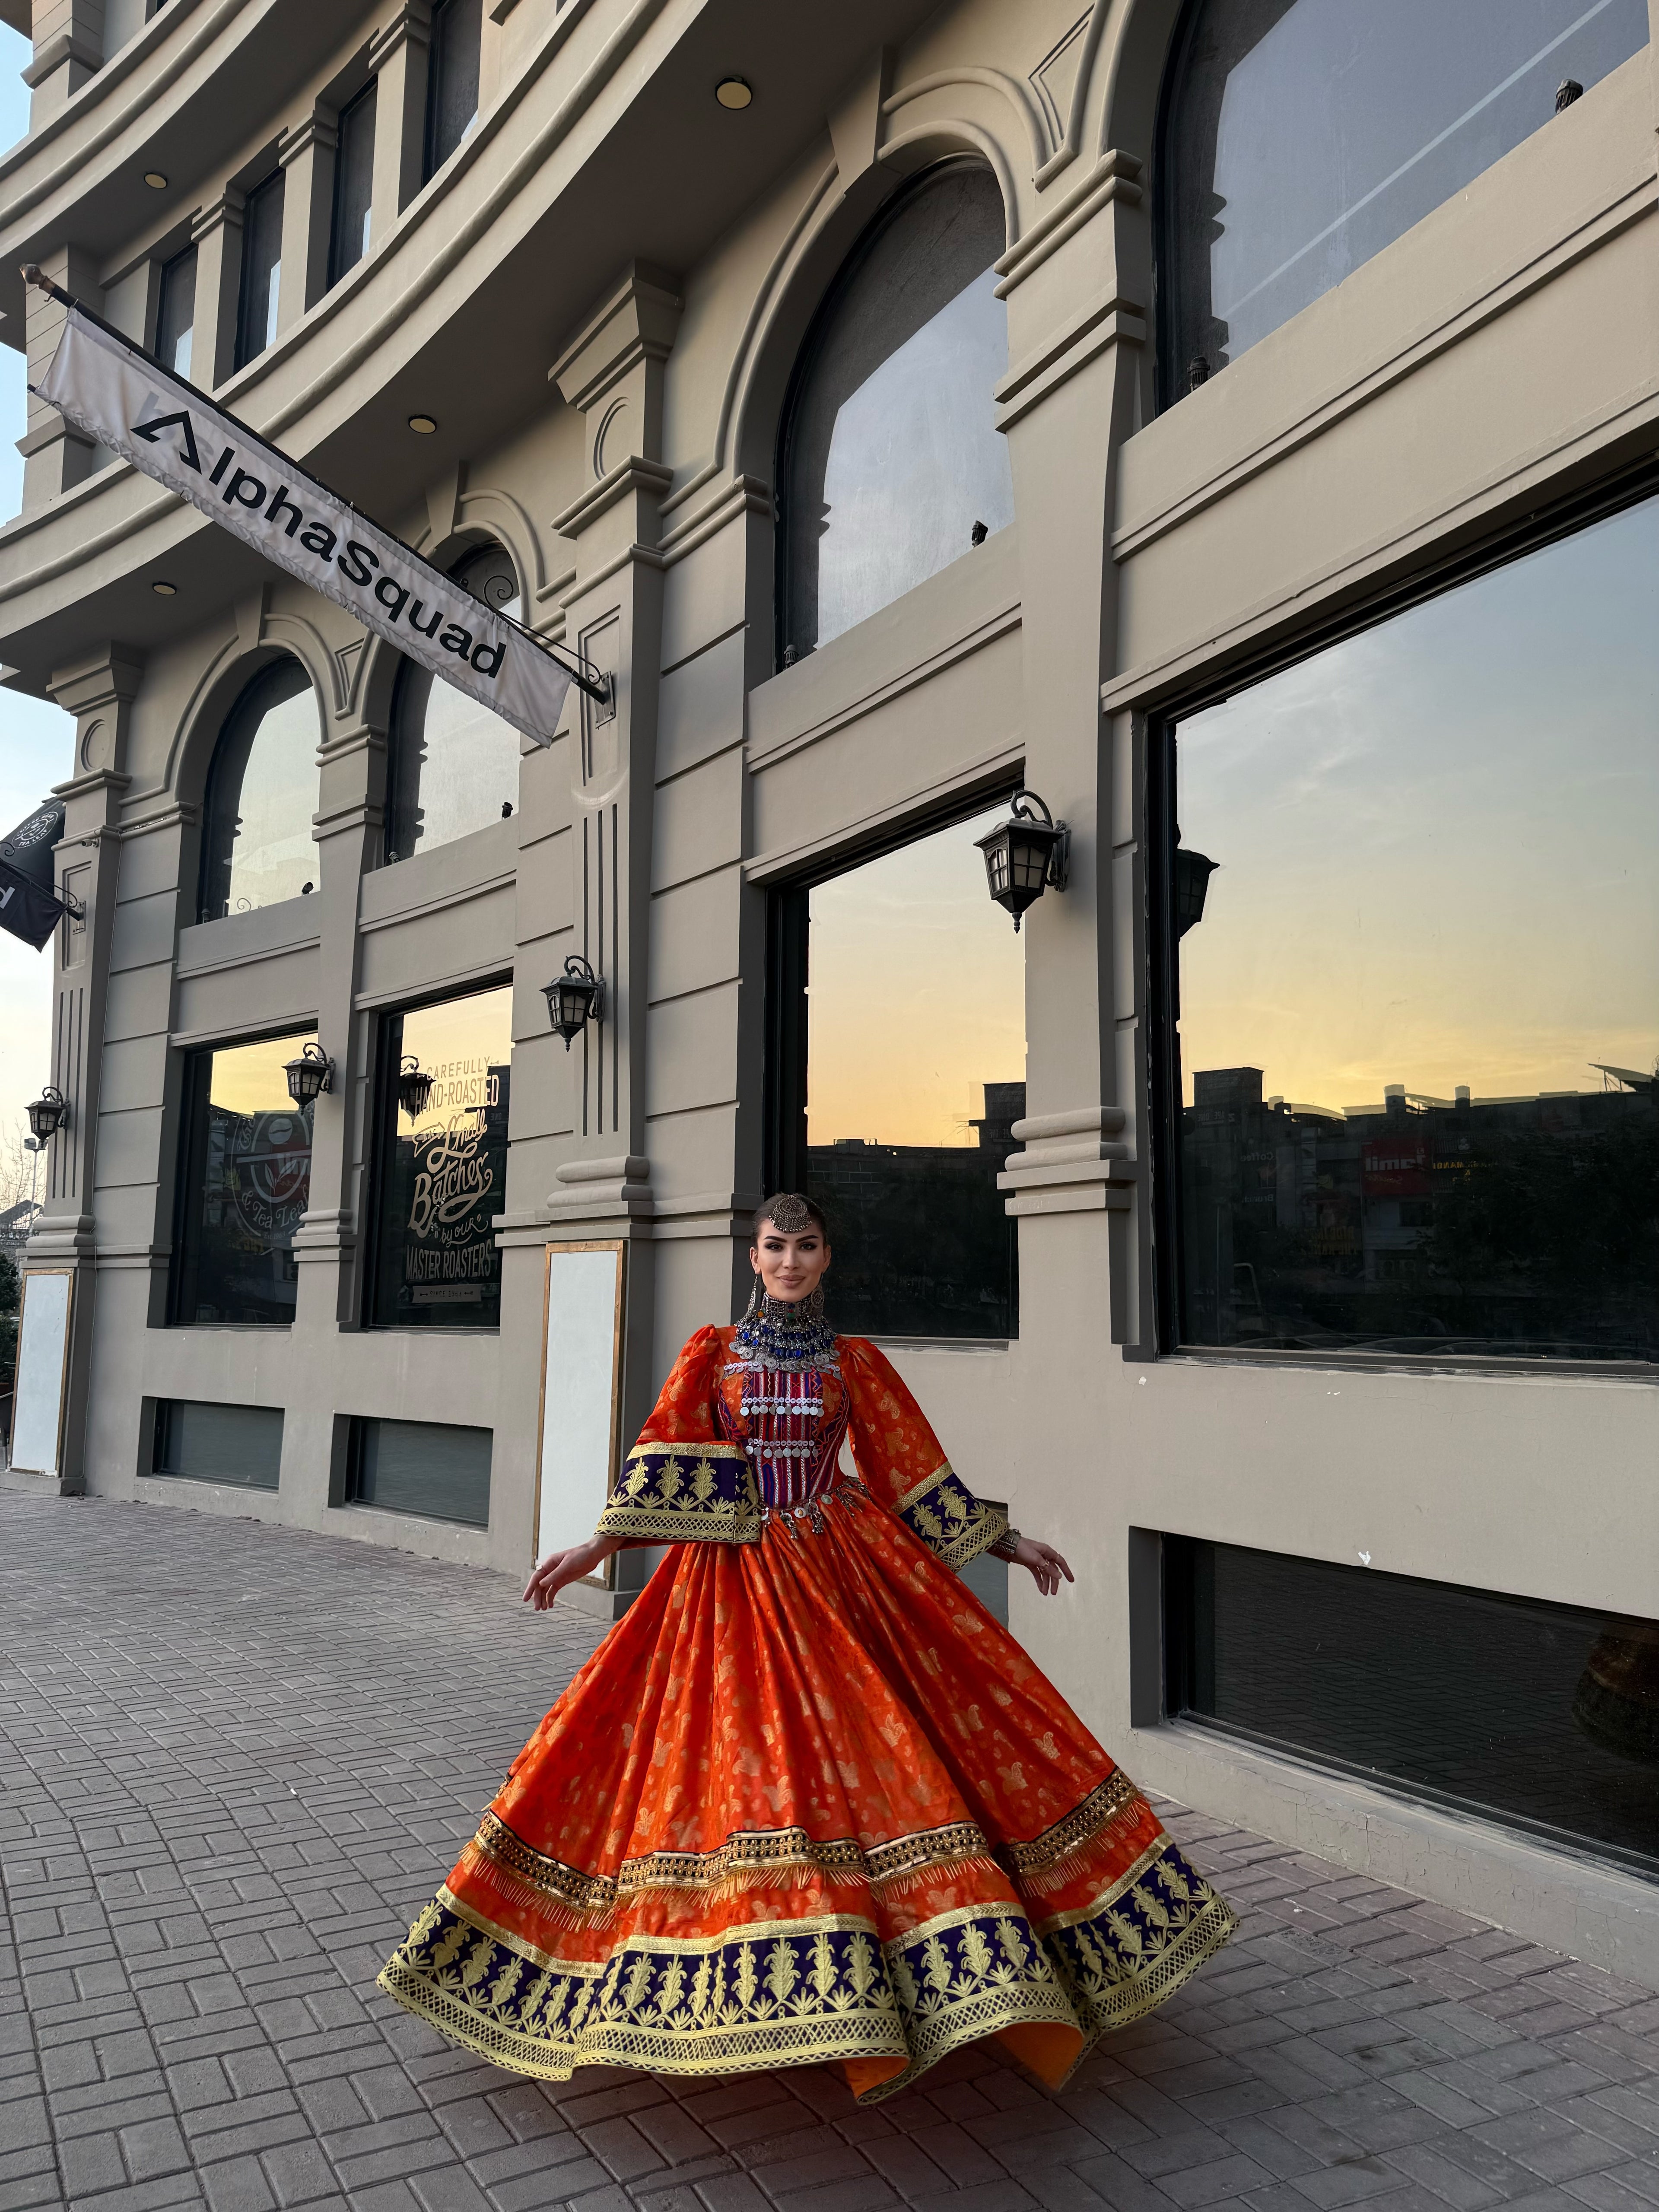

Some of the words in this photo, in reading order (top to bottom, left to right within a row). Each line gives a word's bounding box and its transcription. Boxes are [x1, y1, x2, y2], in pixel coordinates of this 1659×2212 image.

[130, 410, 507, 679] AlphaSquad
[426, 1056, 490, 1081] CAREFULLY
[414, 1074, 499, 1117] HAND-ROASTED
[426, 1109, 488, 1174] Small
[242, 1190, 253, 1211] &
[253, 1200, 273, 1229] Tea
[276, 1184, 308, 1227] Leaf
[408, 1151, 493, 1238] Batches
[406, 1244, 440, 1281] MASTER
[443, 1238, 491, 1279] ROASTERS
[439, 1227, 472, 1248] by
